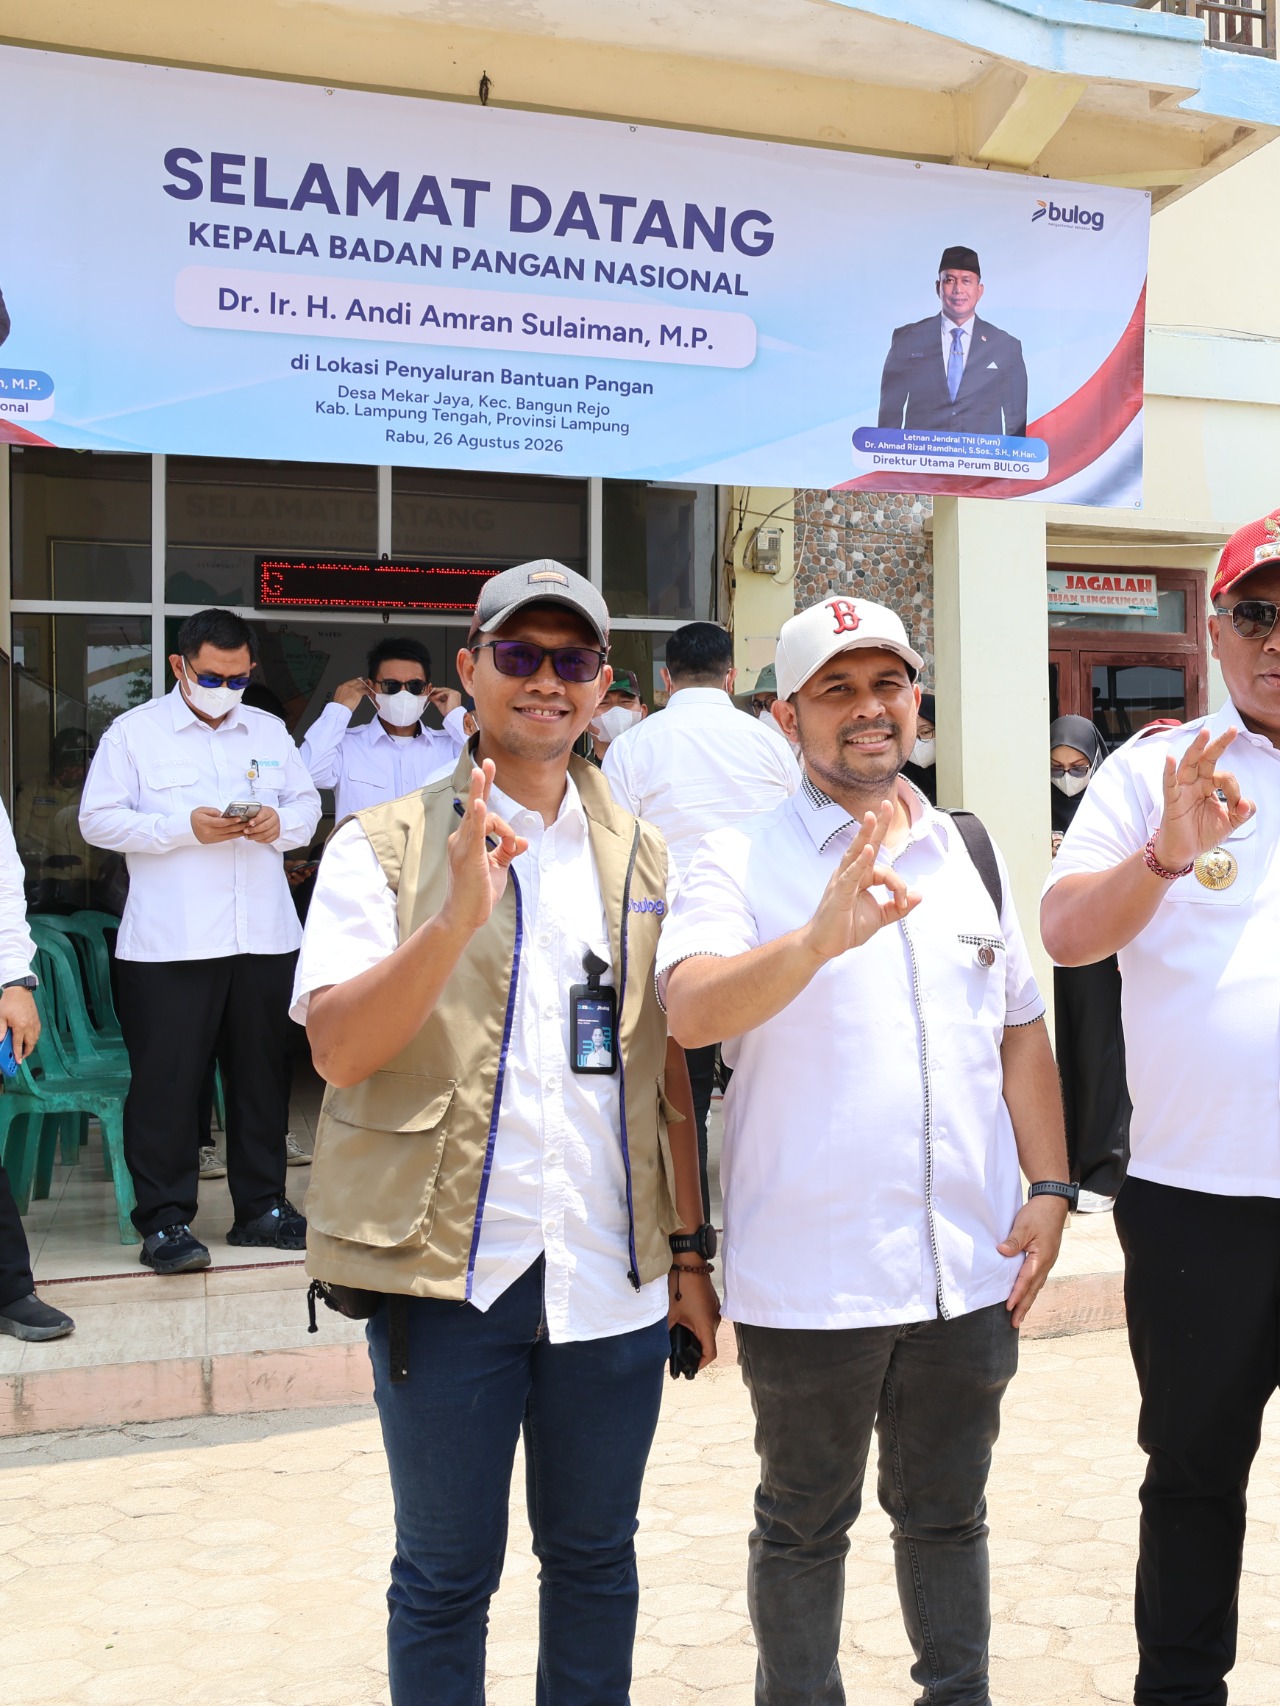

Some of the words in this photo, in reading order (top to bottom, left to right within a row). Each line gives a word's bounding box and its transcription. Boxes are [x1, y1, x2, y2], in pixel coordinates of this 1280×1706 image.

[162, 147, 491, 228] SELAMAT
[509, 184, 775, 257] DATANG
[1048, 201, 1104, 231] bulog
[189, 221, 320, 257] KEPALA
[329, 235, 442, 268] BADAN
[452, 247, 585, 281] PANGAN
[594, 260, 749, 296] NASIONAL
[218, 287, 260, 314] Dr.
[270, 292, 297, 317] Ir.
[307, 295, 336, 320] H.
[345, 299, 411, 325] Andi
[420, 305, 512, 333] Amran
[521, 313, 651, 348] Sulaiman,
[660, 325, 714, 350] M.P.
[12, 378, 41, 390] M.P.
[290, 354, 309, 370] di
[316, 355, 379, 375] Lokasi
[385, 360, 494, 383] Penyaluran
[500, 368, 579, 389] Bantuan
[585, 375, 654, 397] Pangan
[338, 385, 376, 400] Desa
[381, 388, 429, 404] Mekar
[433, 392, 474, 409] Jaya,
[479, 395, 511, 409] Kec.
[516, 397, 572, 414] Bangun
[577, 401, 610, 418] Rejo
[315, 401, 349, 415] Kab.
[354, 403, 427, 423] Lampung
[432, 408, 491, 426] Tengah,
[496, 412, 556, 428] Provinsi
[561, 417, 630, 436] Lampung
[385, 429, 428, 446] Rabu,
[433, 432, 453, 445] 26
[457, 433, 520, 450] Agustus
[524, 438, 563, 452] 2026
[864, 440, 877, 449] Dr.
[878, 441, 905, 450] Ahmad
[907, 443, 925, 451] Rizal
[927, 444, 967, 454] Ramdhani,
[903, 433, 930, 442] Letnan
[932, 435, 960, 444] Jendral
[962, 436, 975, 445] TNI
[977, 437, 1001, 446] (Purn)
[873, 455, 918, 466] Direktur
[919, 457, 954, 468] Utama
[957, 460, 991, 470] Perum
[994, 462, 1030, 473] BULOG
[1065, 575, 1152, 592] JAGALAH
[1080, 595, 1154, 606] LINGKUNGAN
[825, 599, 863, 634] B
[630, 896, 665, 916] bulog
